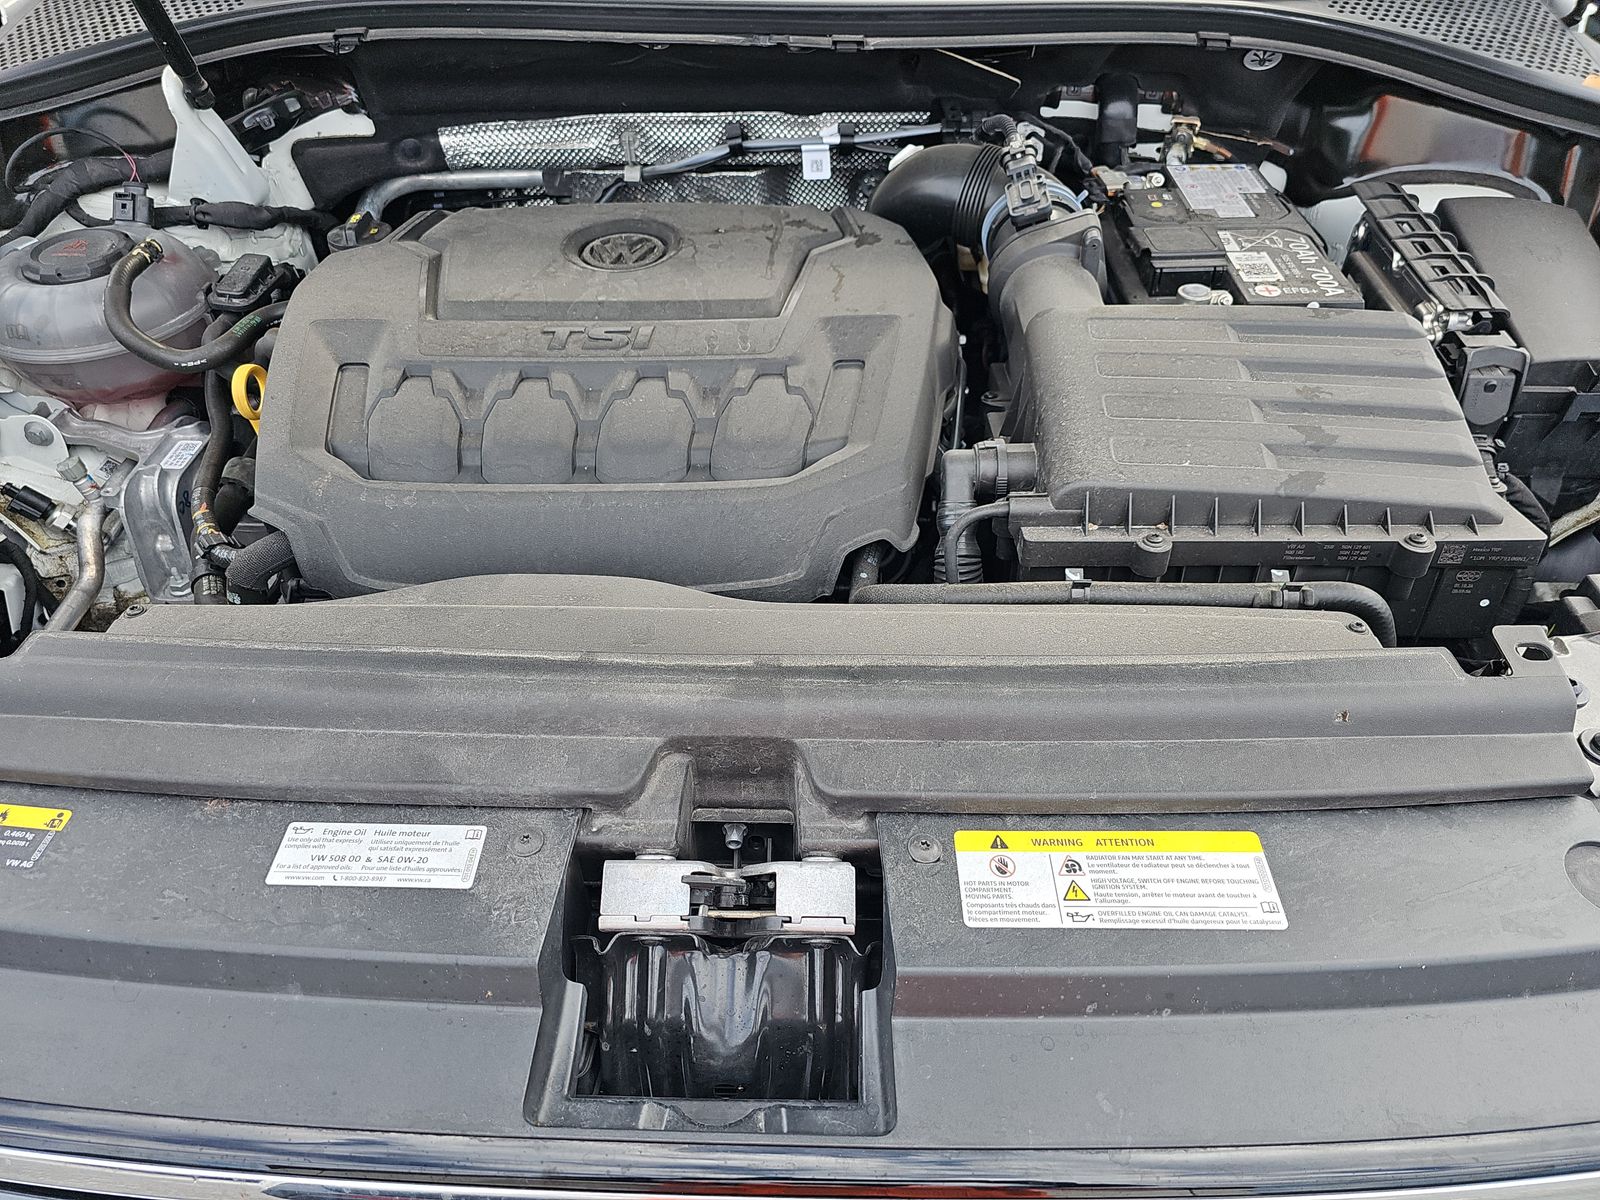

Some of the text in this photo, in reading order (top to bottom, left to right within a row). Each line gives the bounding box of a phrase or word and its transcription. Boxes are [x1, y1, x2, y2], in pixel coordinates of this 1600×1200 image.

[1284, 236, 1318, 264] 70Ah
[1306, 266, 1344, 296] 700A
[542, 326, 655, 350] TSI
[322, 829, 352, 837] Engine
[1031, 838, 1155, 847] WARNING ATTENTION
[6, 859, 21, 867] VW
